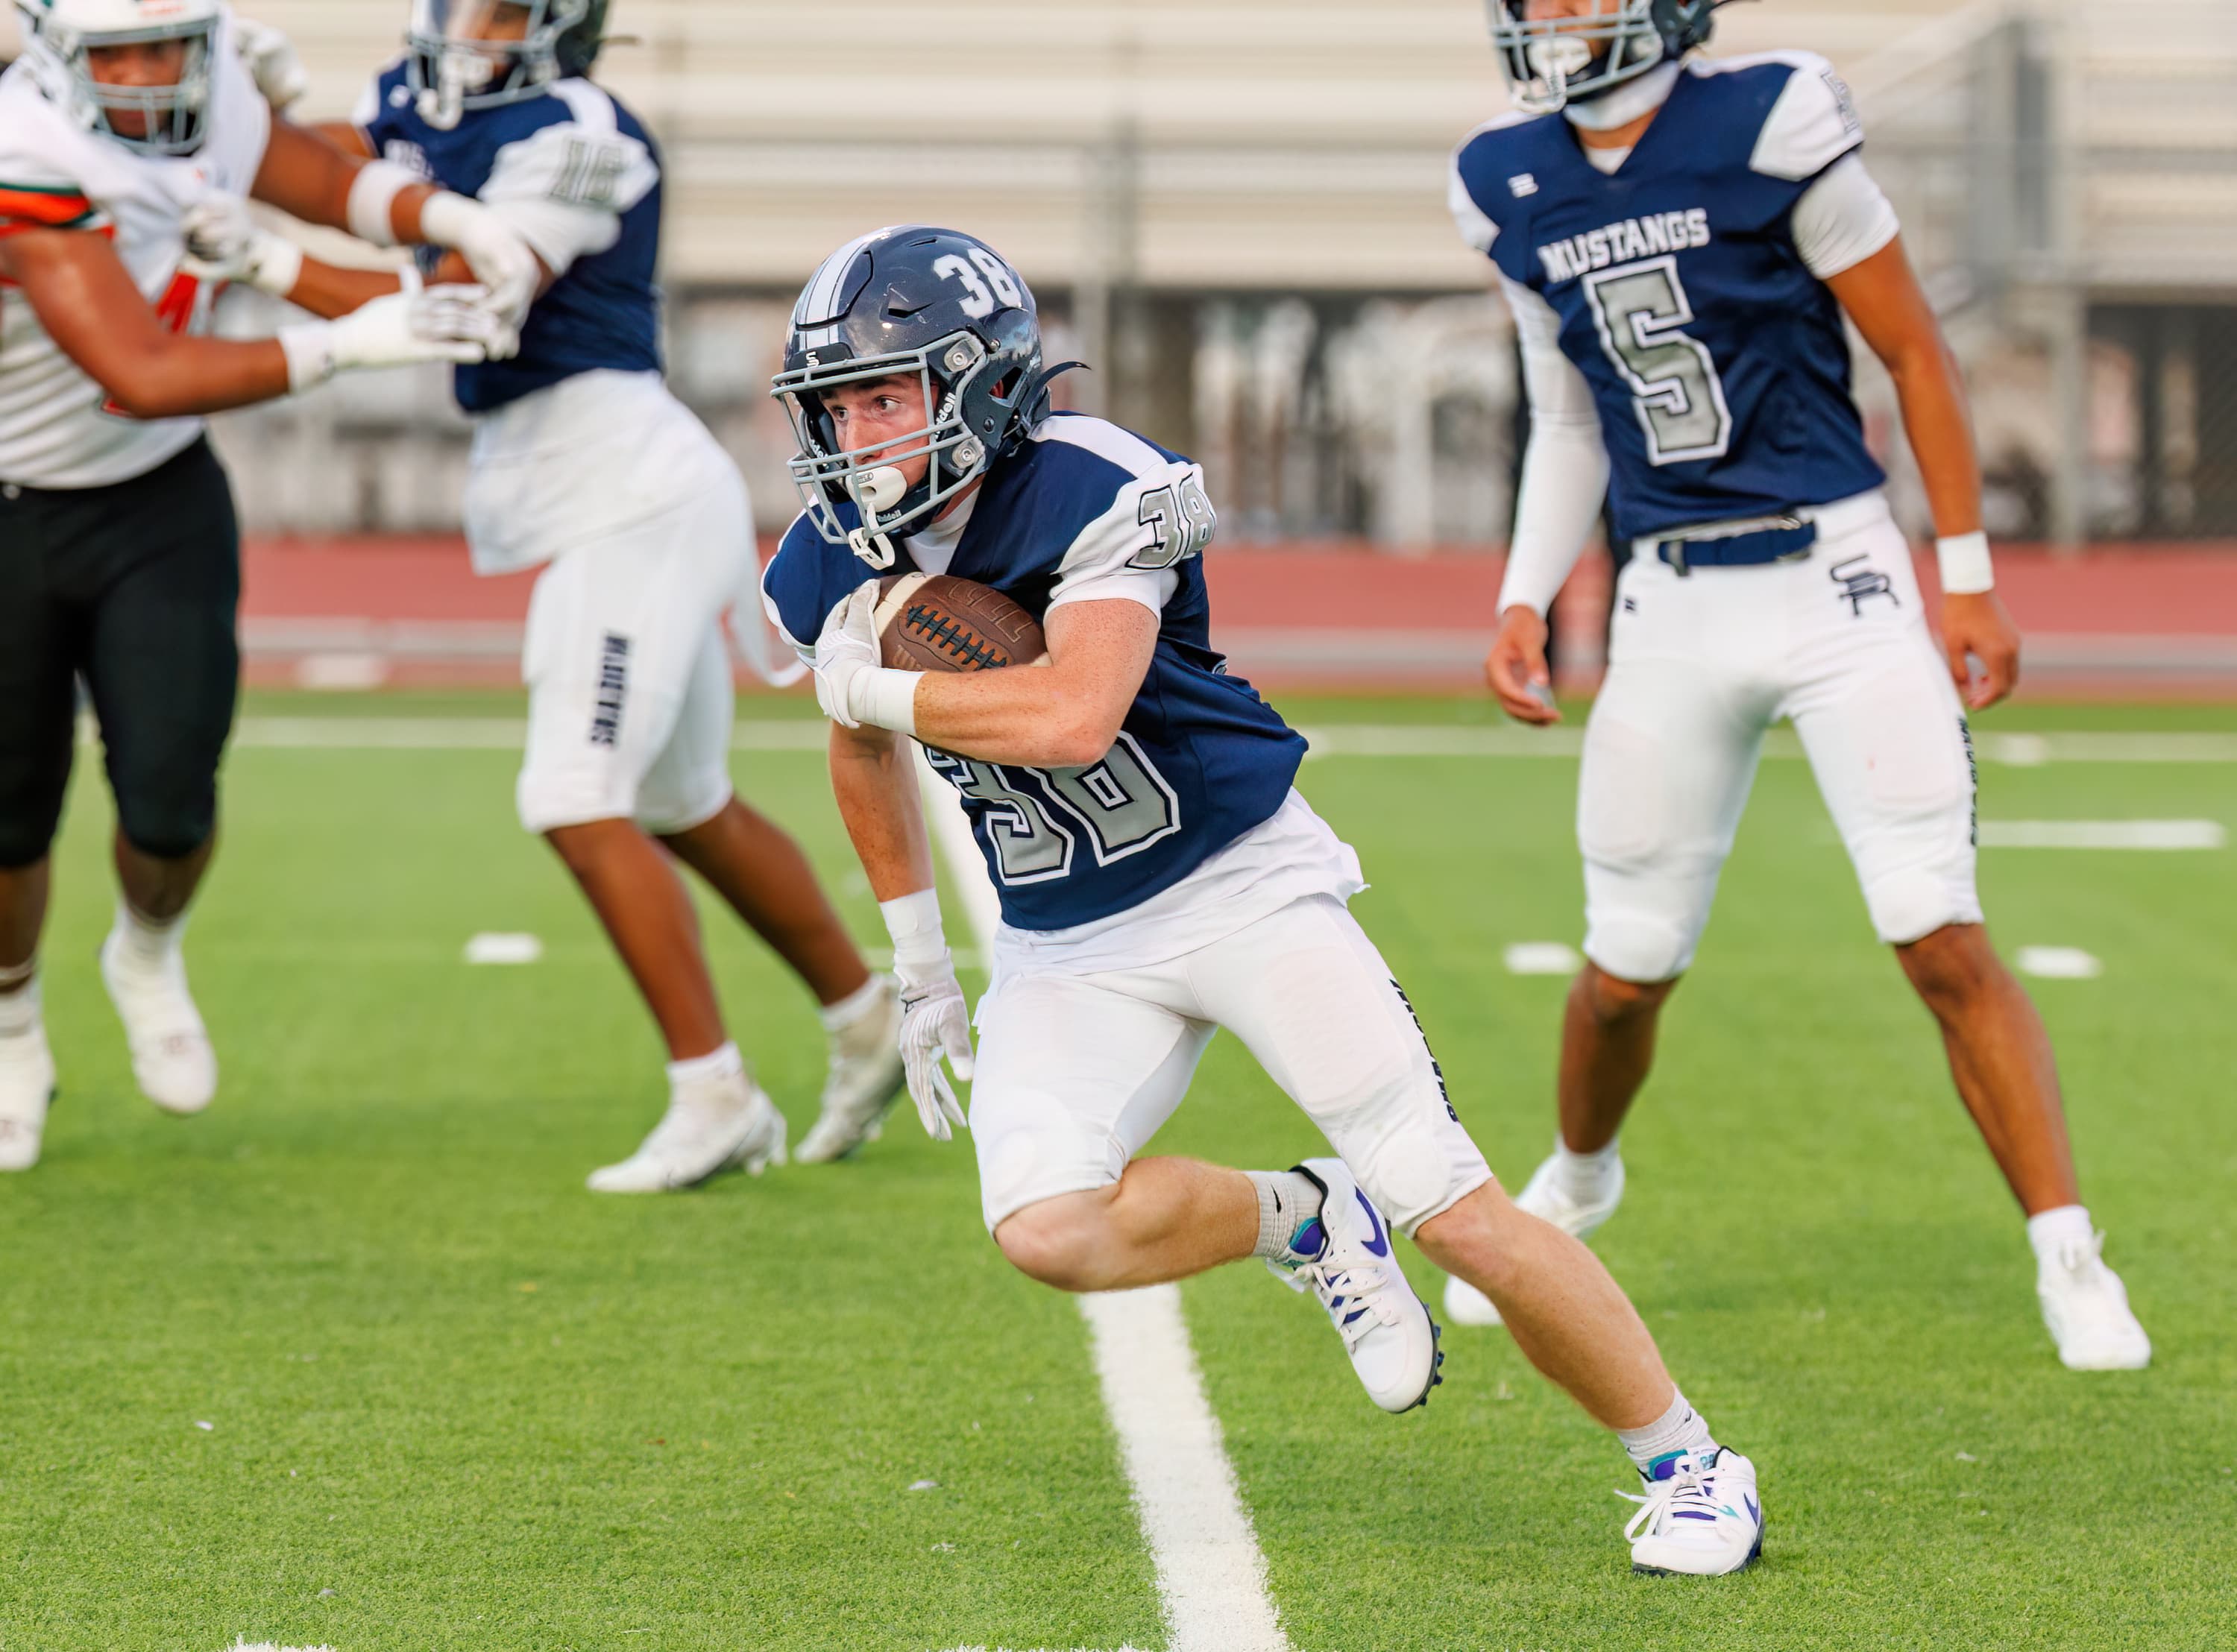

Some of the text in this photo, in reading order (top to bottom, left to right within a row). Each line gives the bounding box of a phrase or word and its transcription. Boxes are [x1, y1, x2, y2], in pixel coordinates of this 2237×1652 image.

[933, 248, 1022, 321] 38
[1537, 207, 1711, 283] MUSTANGS
[1581, 253, 1733, 467] 5
[1124, 471, 1217, 570] 38
